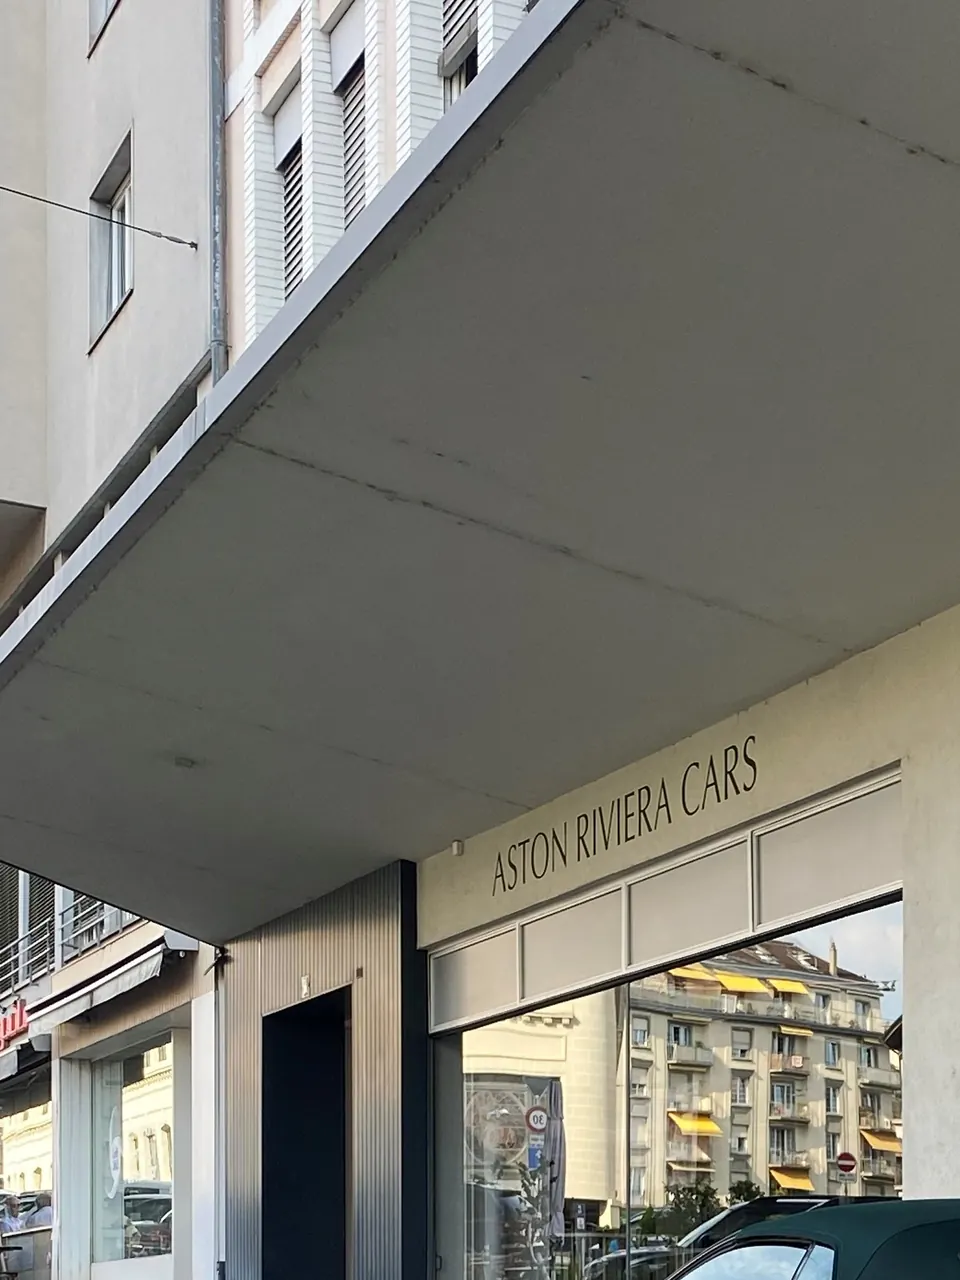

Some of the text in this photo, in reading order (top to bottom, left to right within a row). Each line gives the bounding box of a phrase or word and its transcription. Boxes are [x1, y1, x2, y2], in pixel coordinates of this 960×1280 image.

[492, 735, 758, 897] ASTON RIVIERA CARS
